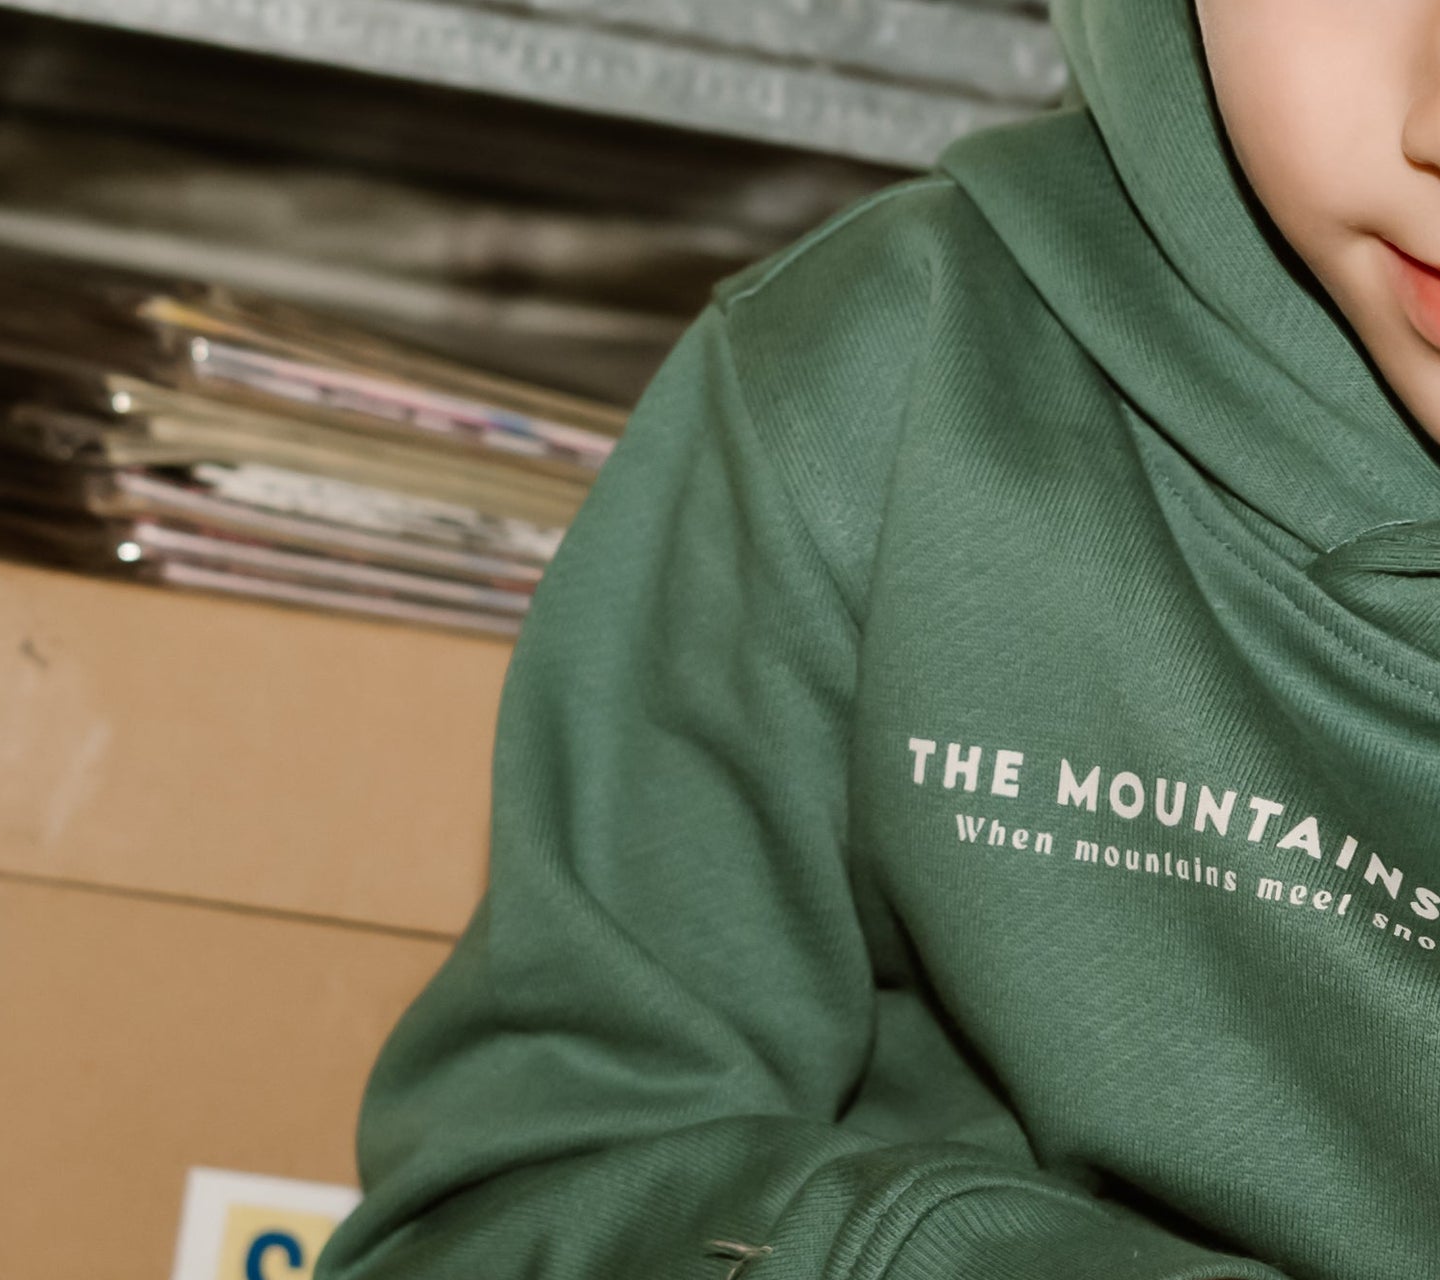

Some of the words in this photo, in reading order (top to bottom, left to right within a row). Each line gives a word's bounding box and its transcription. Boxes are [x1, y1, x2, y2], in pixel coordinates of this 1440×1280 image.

[908, 737, 1024, 798] THE
[956, 814, 1053, 855] When
[1075, 839, 1237, 892] mountains
[1257, 877, 1352, 915] meet
